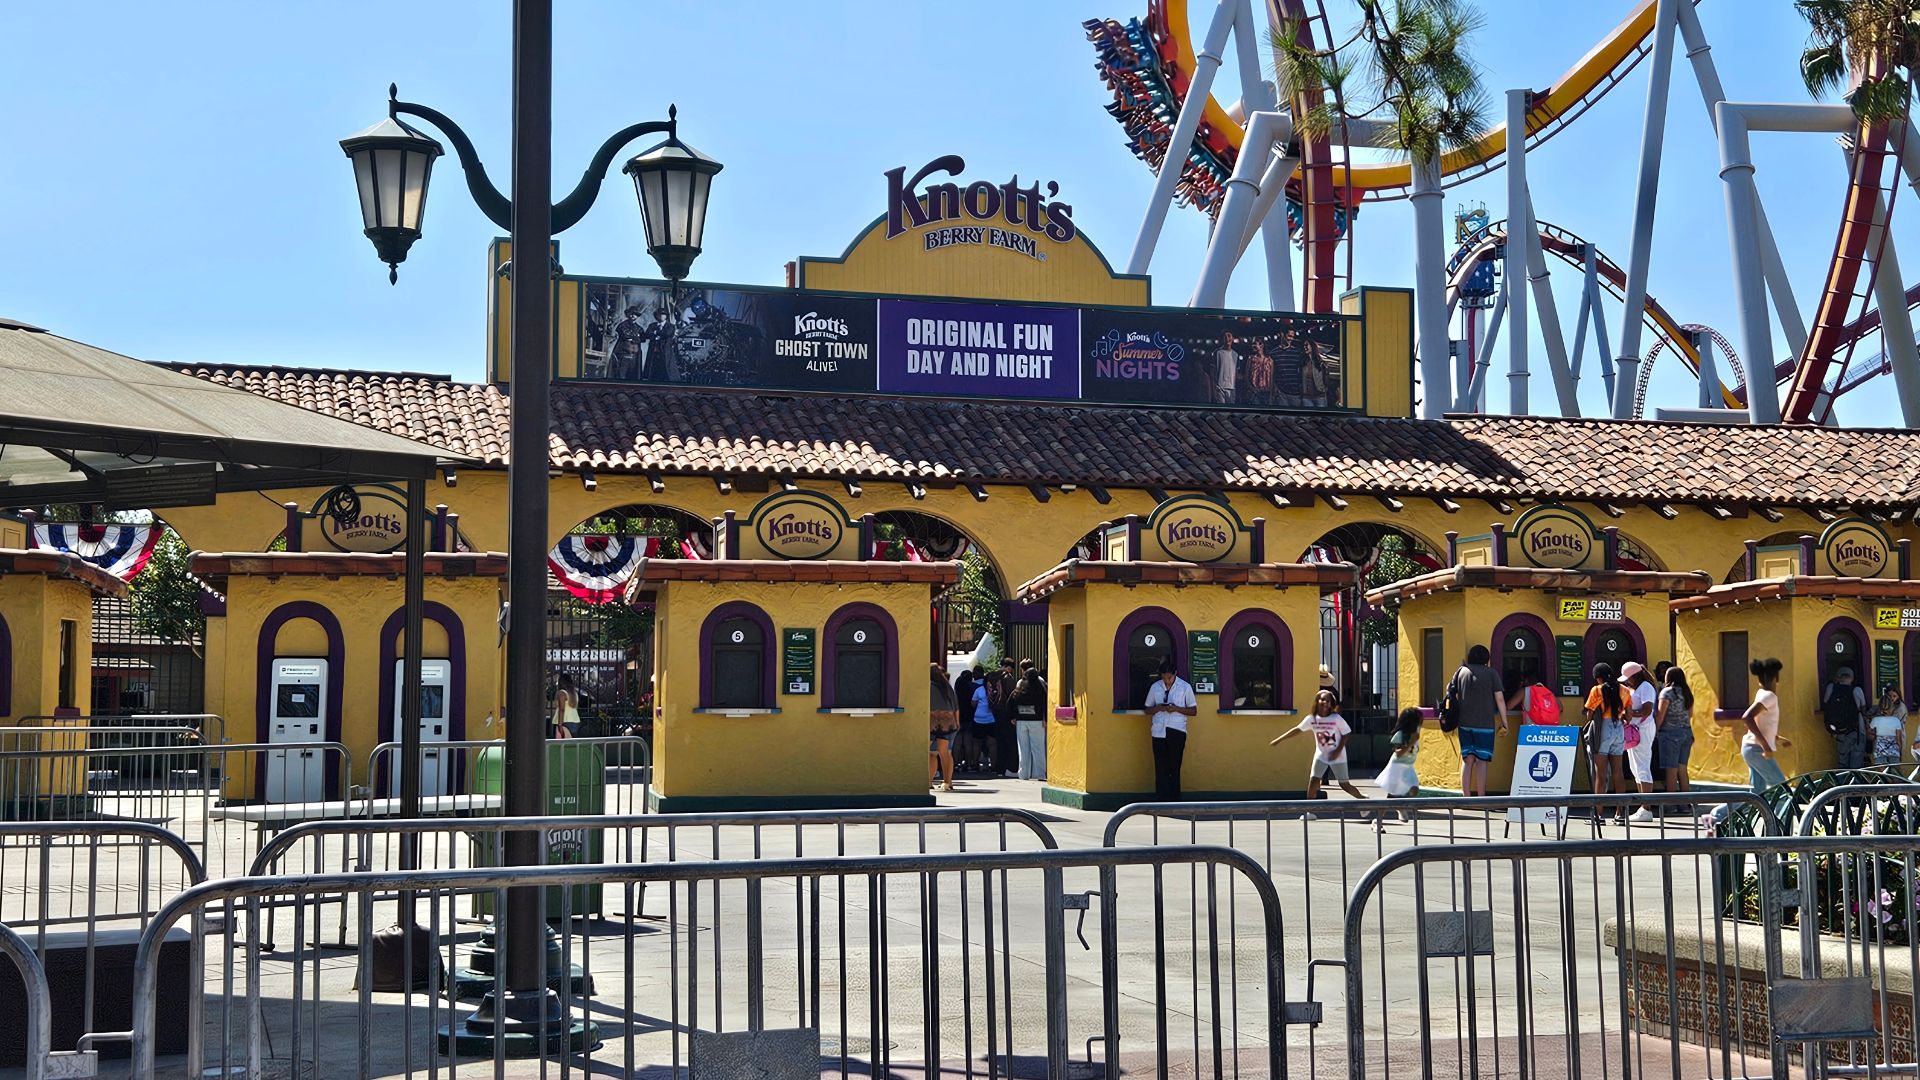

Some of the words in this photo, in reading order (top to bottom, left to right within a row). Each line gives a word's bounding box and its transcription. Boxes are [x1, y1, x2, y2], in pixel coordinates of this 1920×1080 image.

[884, 154, 1076, 243] Knott's
[924, 227, 985, 251] BERRY
[988, 227, 1038, 260] FARM
[794, 311, 849, 336] Knott's
[907, 318, 1007, 349] ORIGINAL
[1013, 323, 1053, 351] FUN
[1126, 331, 1151, 343] Knott's
[775, 339, 821, 357] GHOST
[824, 341, 868, 360] TOWN
[1113, 342, 1163, 361] Summer
[805, 360, 838, 372] ALIVE!
[907, 349, 945, 375] DAY
[950, 351, 990, 377] AND
[995, 353, 1053, 379] NIGHT
[1096, 359, 1180, 380] NIGHTS
[768, 513, 832, 542] Knott's
[1168, 518, 1227, 545] Knott's
[1530, 527, 1583, 553] Knott's
[1835, 539, 1881, 564] Knott's
[1588, 610, 1622, 620] HERE
[1590, 600, 1622, 611] SOLD
[735, 632, 741, 640] 5
[857, 632, 863, 640] 6
[1607, 641, 1616, 649] 10
[1526, 735, 1570, 743] CASHLESS
